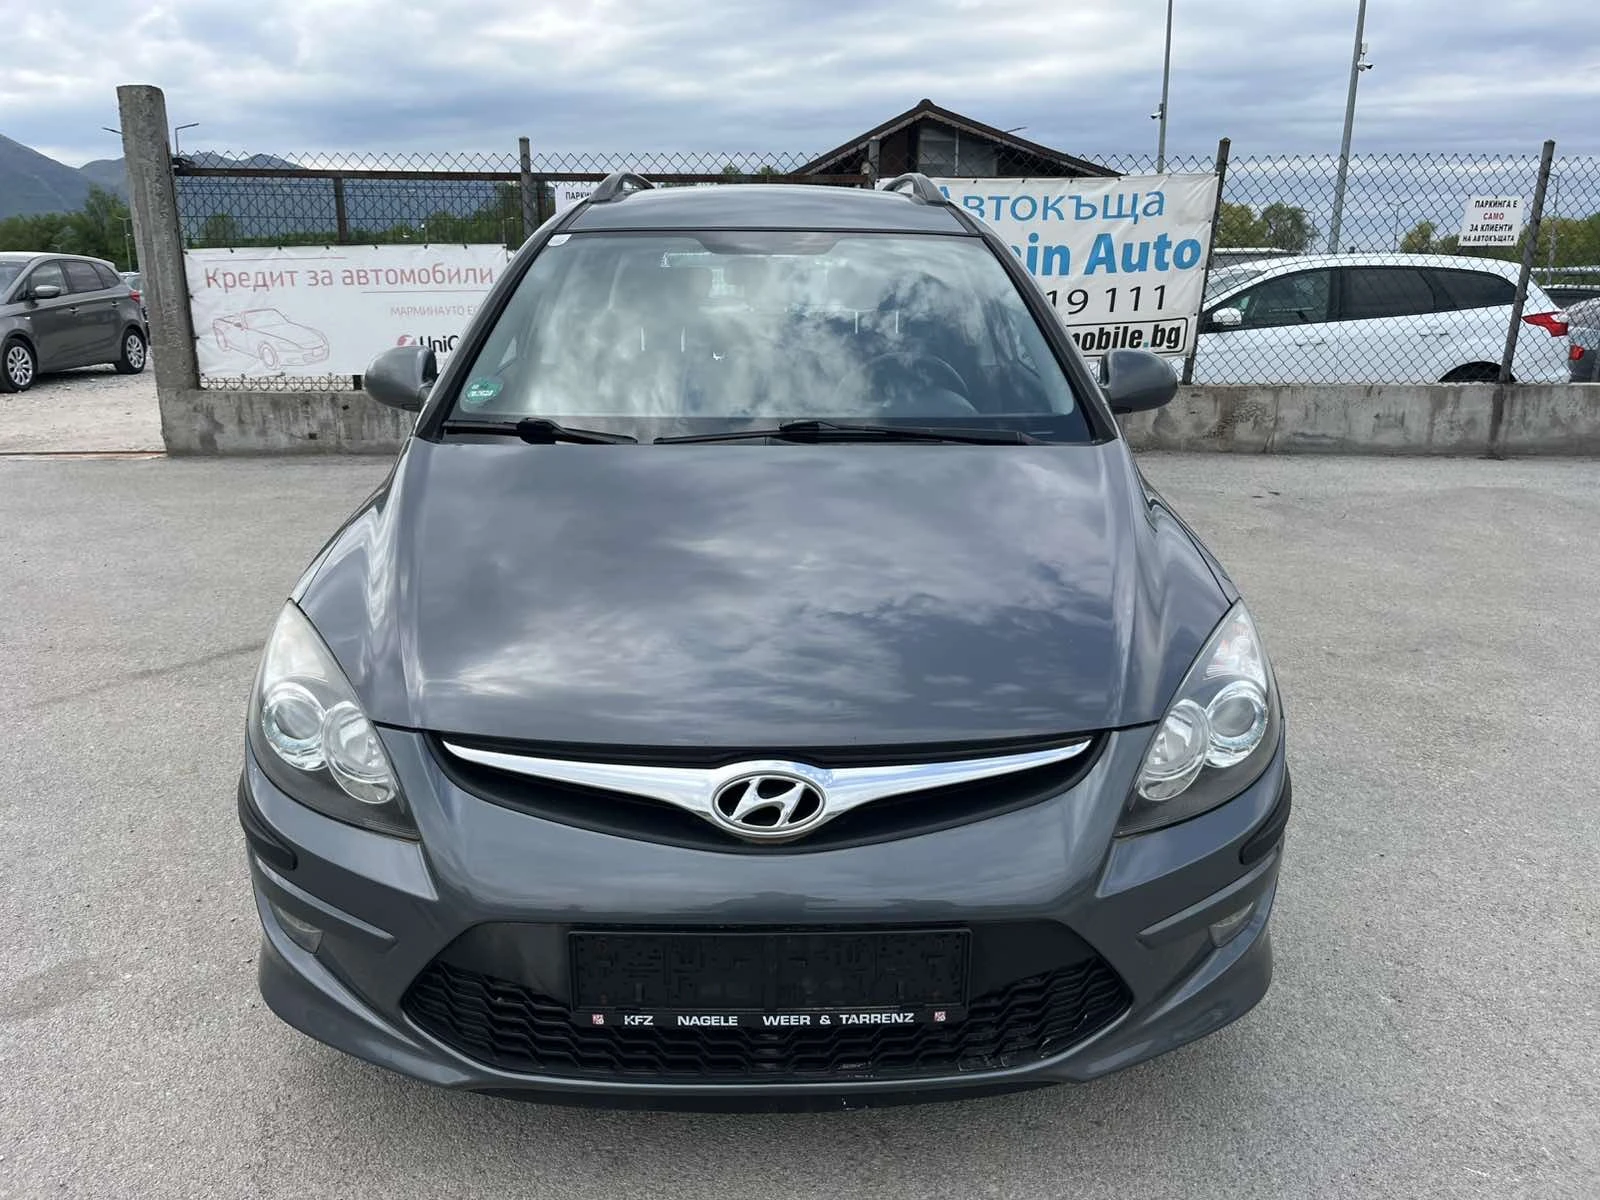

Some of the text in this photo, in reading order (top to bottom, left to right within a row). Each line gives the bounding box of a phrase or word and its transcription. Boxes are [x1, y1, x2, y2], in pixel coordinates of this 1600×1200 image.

[565, 191, 591, 200] ПАРКИ
[1474, 200, 1518, 209] ПАРКИНГА Е
[1483, 212, 1505, 220] САМО
[1469, 223, 1513, 232] ЗА КЛИЕНТИ
[1010, 232, 1201, 276] in Auto
[204, 262, 494, 294] Кредит за автомобили
[1105, 285, 1166, 313] 111
[390, 304, 465, 316] МАРМИНАУТО
[624, 1012, 915, 1026] KFZ NAGELE WEER & TARRENZ
